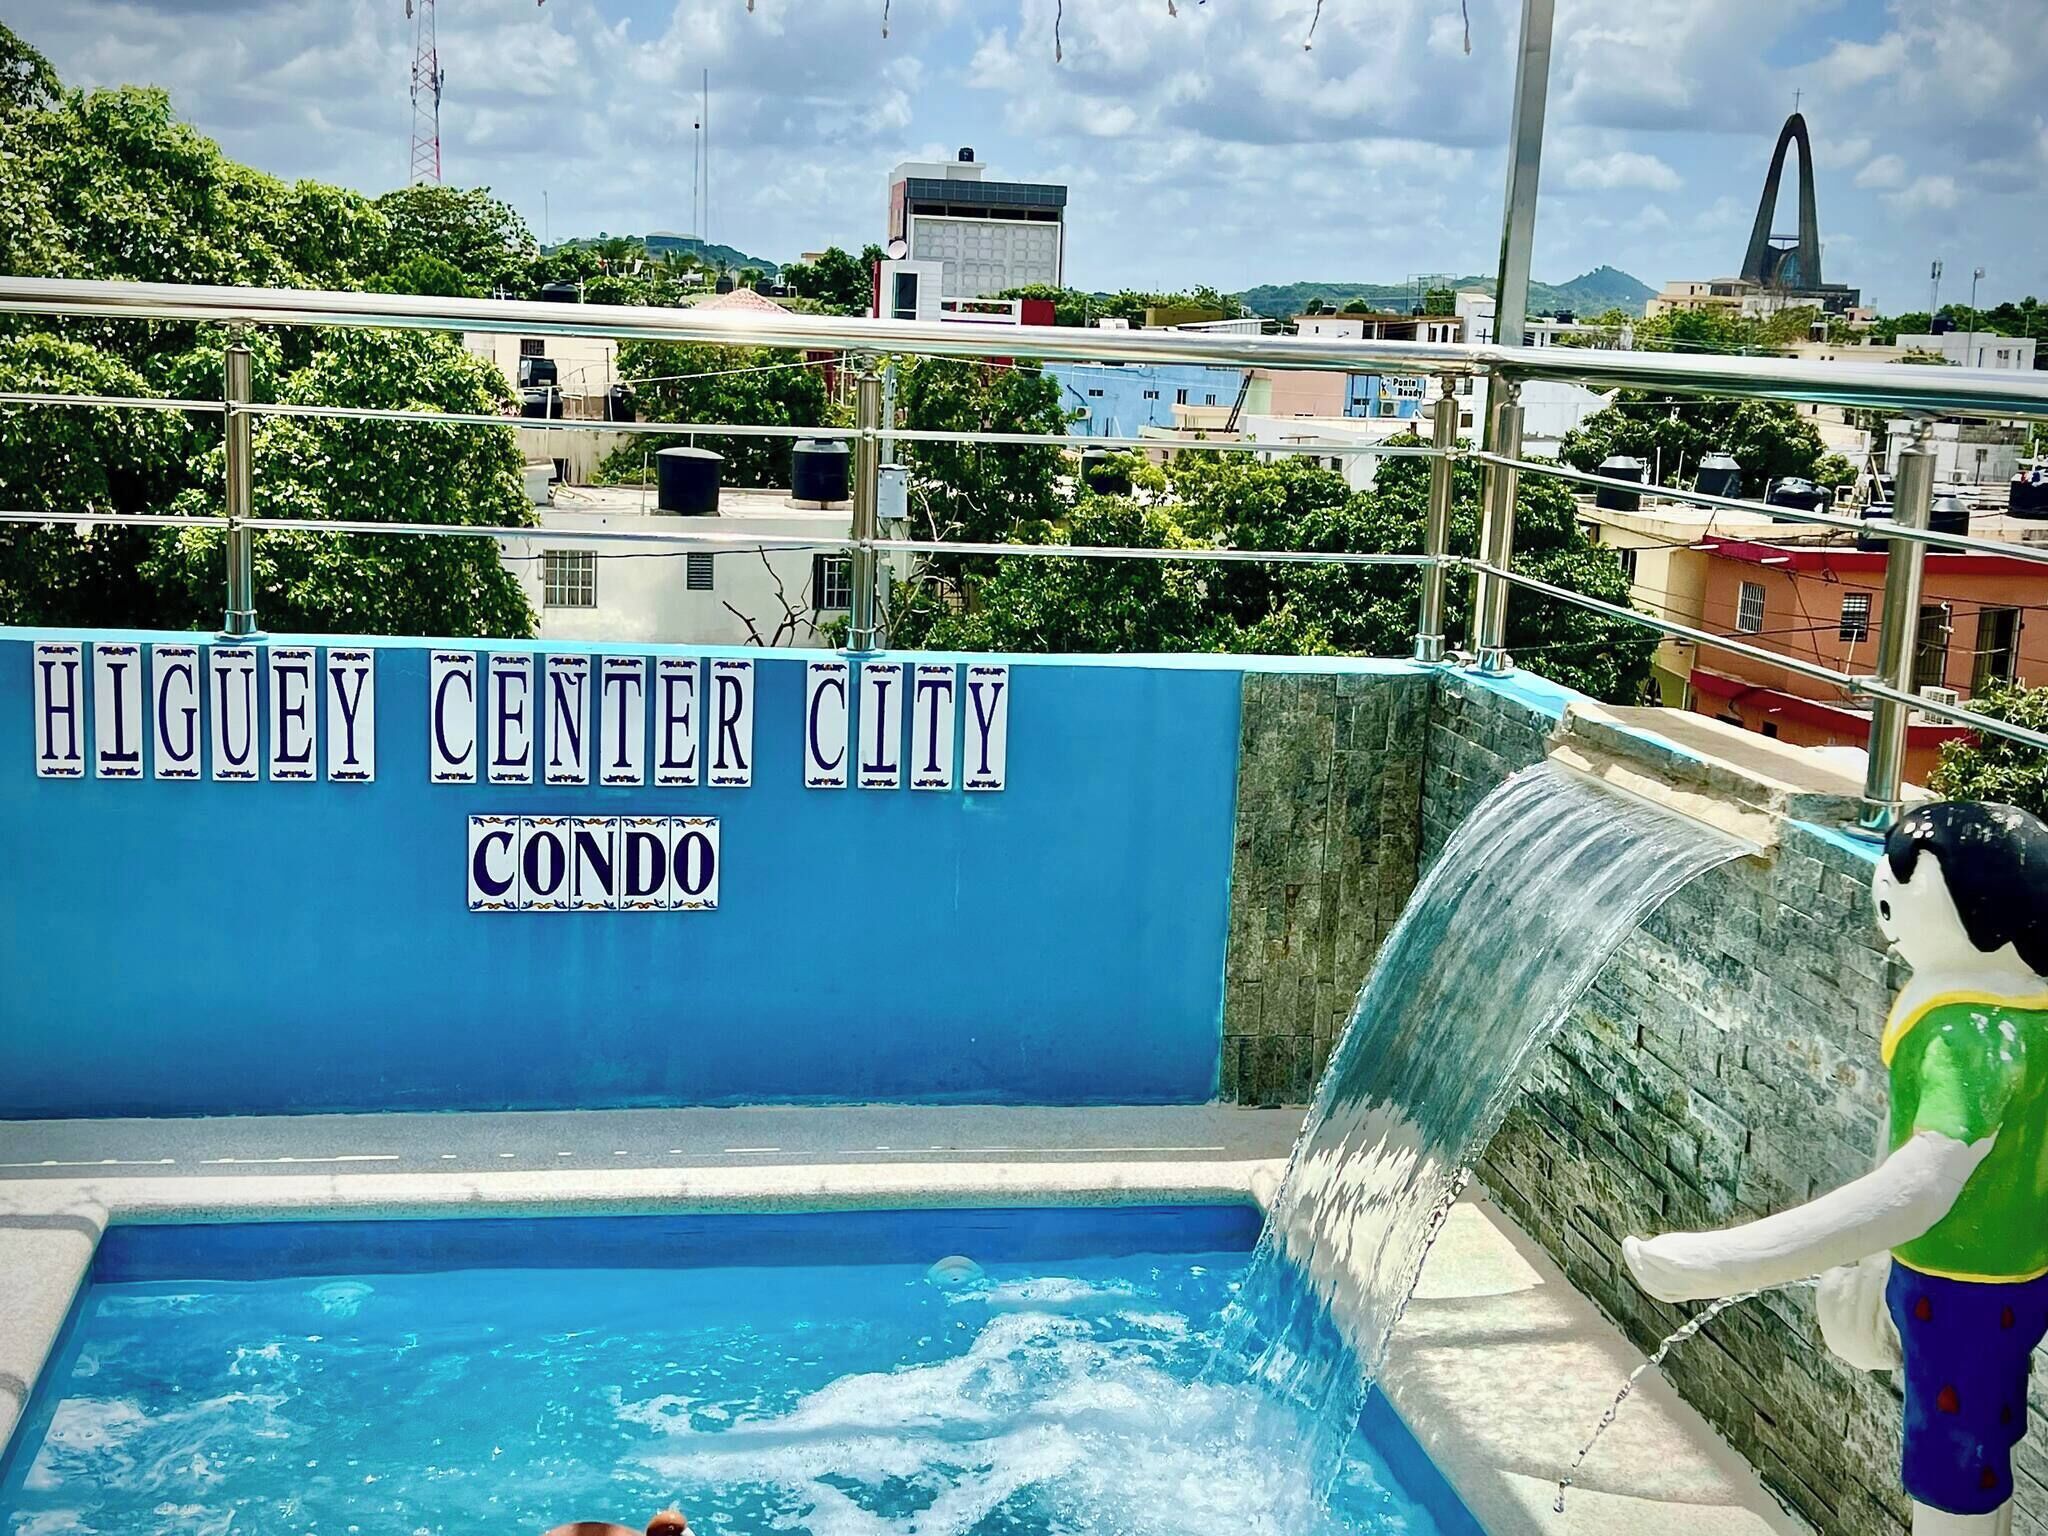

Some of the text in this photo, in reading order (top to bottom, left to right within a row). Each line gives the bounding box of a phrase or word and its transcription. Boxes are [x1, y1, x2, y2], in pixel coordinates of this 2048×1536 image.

[1397, 387, 1423, 399] Ready
[38, 660, 370, 766] HIGUEY
[809, 677, 1005, 775] CITY
[472, 830, 716, 898] CONDO
